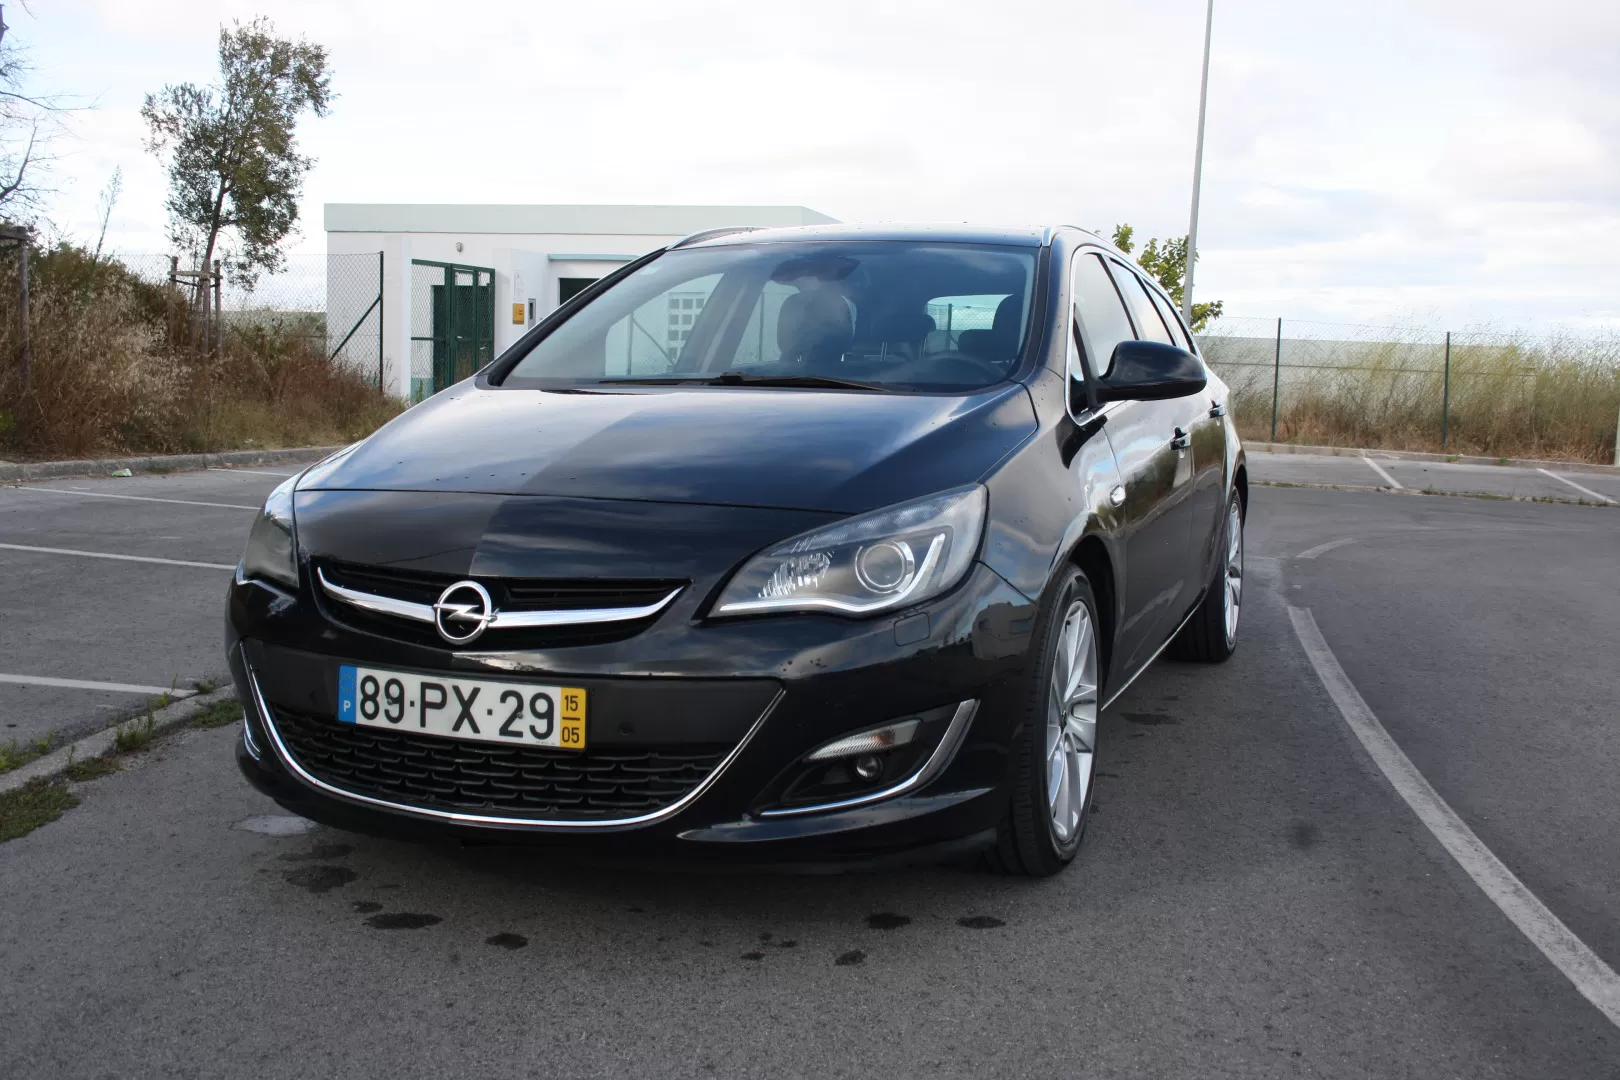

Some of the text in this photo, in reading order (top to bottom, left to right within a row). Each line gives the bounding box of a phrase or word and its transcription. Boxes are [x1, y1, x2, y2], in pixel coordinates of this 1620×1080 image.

[343, 699, 352, 713] P
[564, 694, 579, 711] 15
[561, 726, 580, 743] 05
